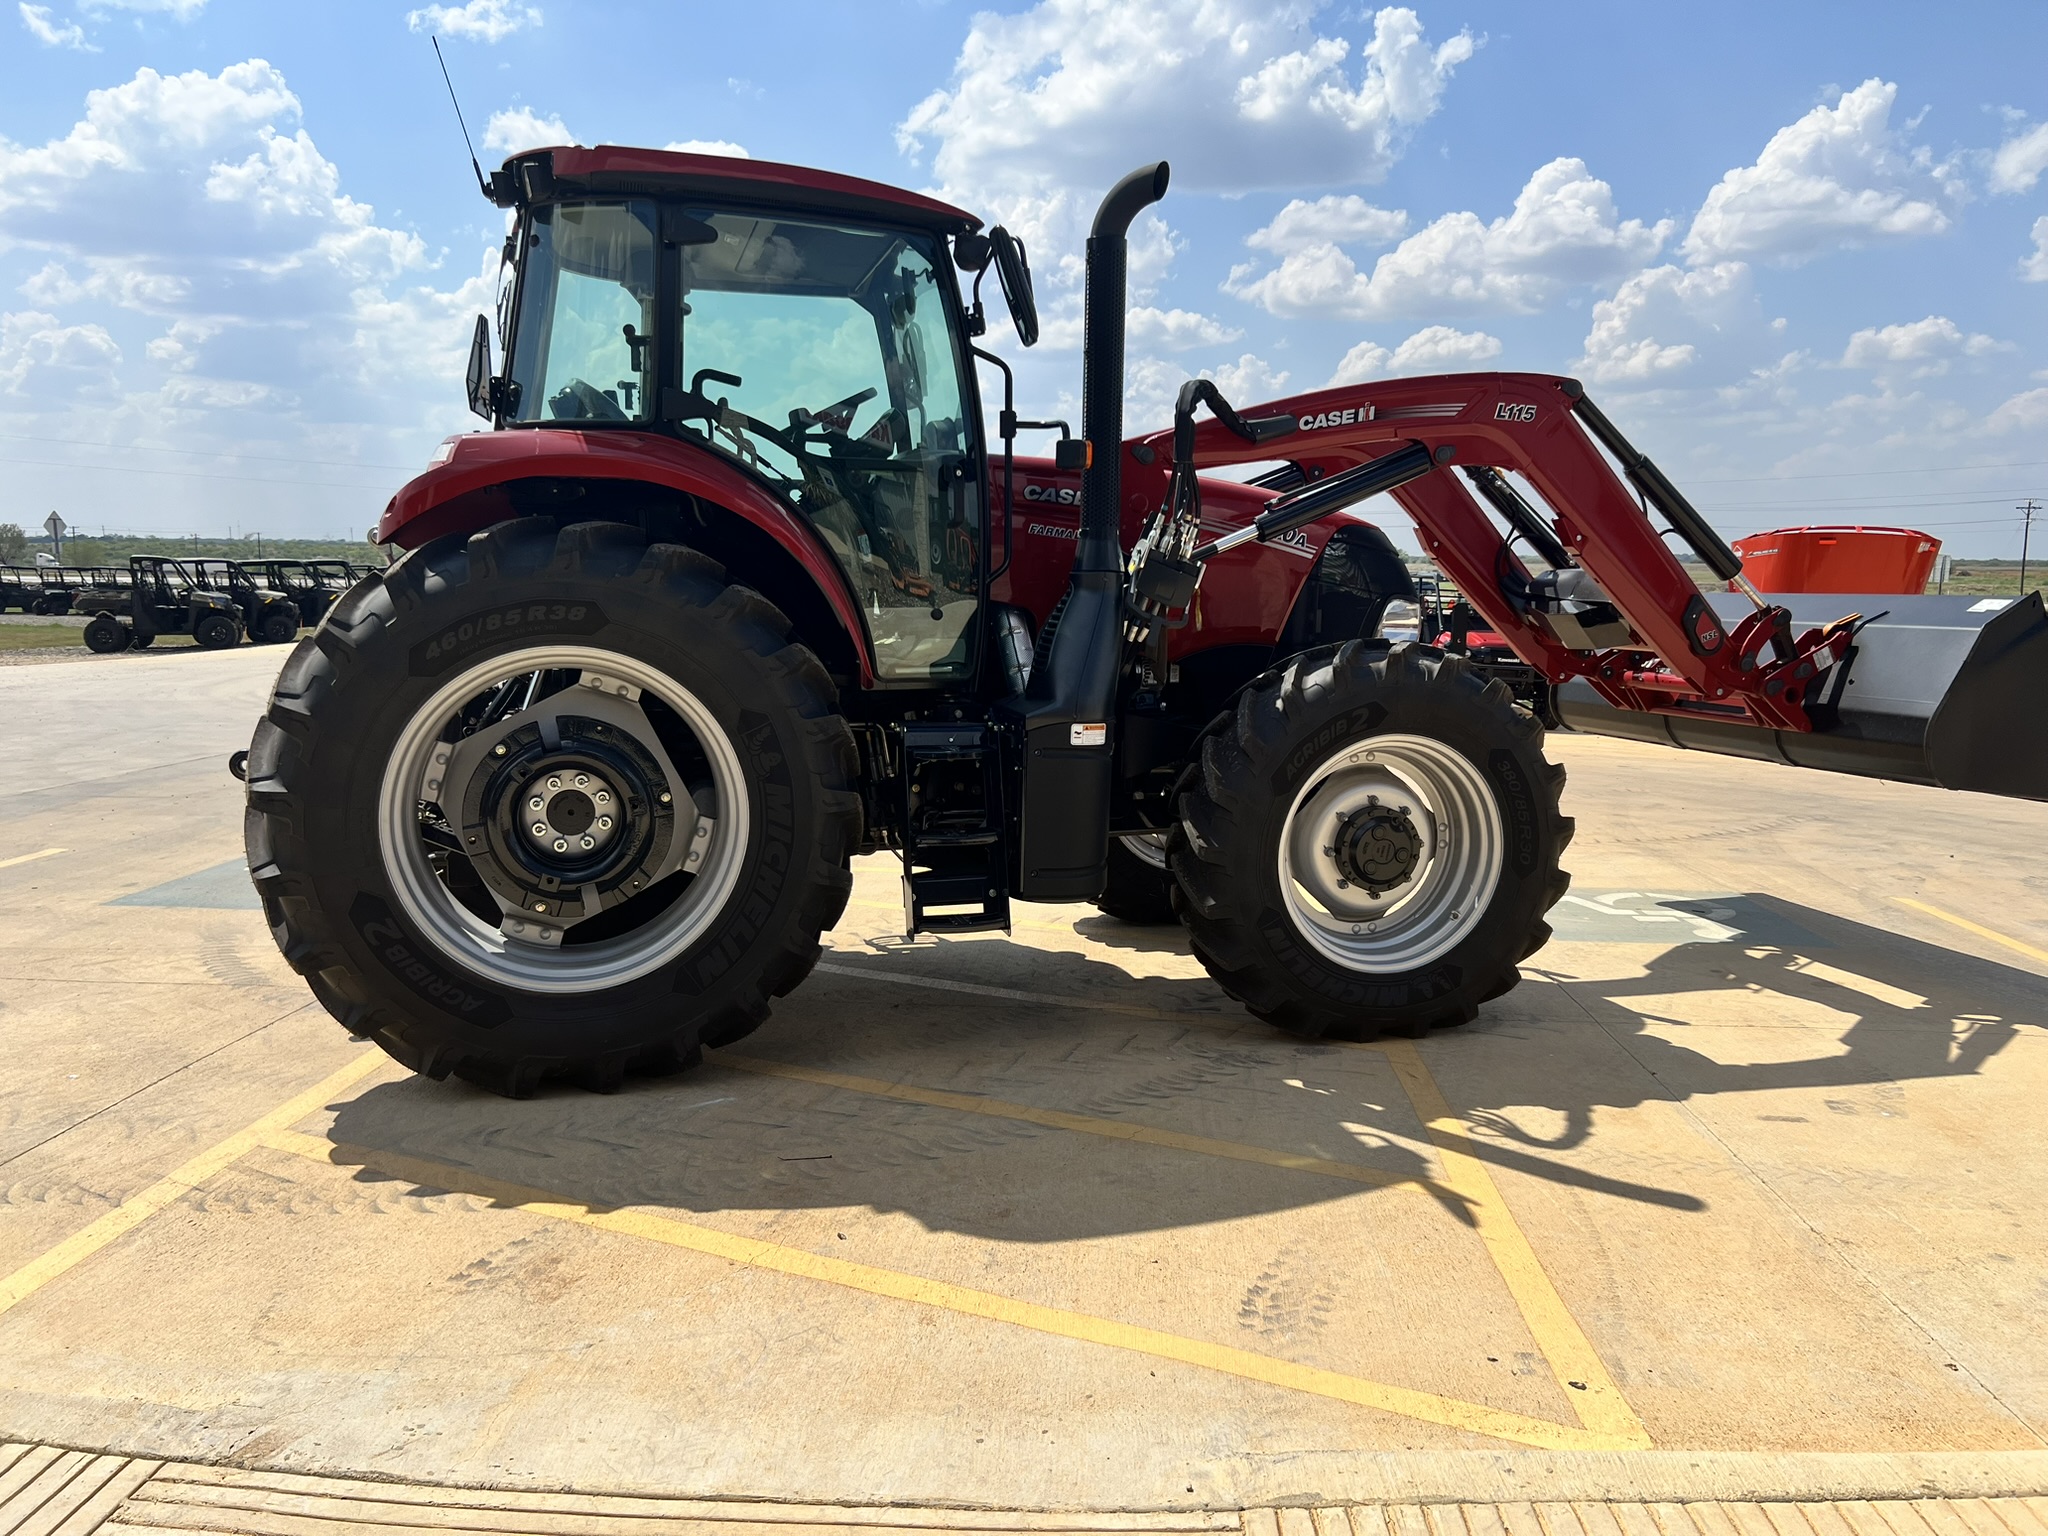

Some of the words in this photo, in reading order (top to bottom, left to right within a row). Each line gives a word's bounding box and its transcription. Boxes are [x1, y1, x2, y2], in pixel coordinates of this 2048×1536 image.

[1299, 408, 1355, 431] CASE
[1494, 402, 1537, 422] L115
[1028, 523, 1082, 540] FARMAL
[1275, 528, 1308, 548] 0A
[1285, 719, 1348, 781] AGRIBIB
[1350, 707, 1369, 735] 2
[696, 783, 794, 986] MICHELIN
[363, 918, 404, 946] 2
[385, 944, 486, 1012] AGRIBIB
[1263, 927, 1408, 1006] MICHELIN
